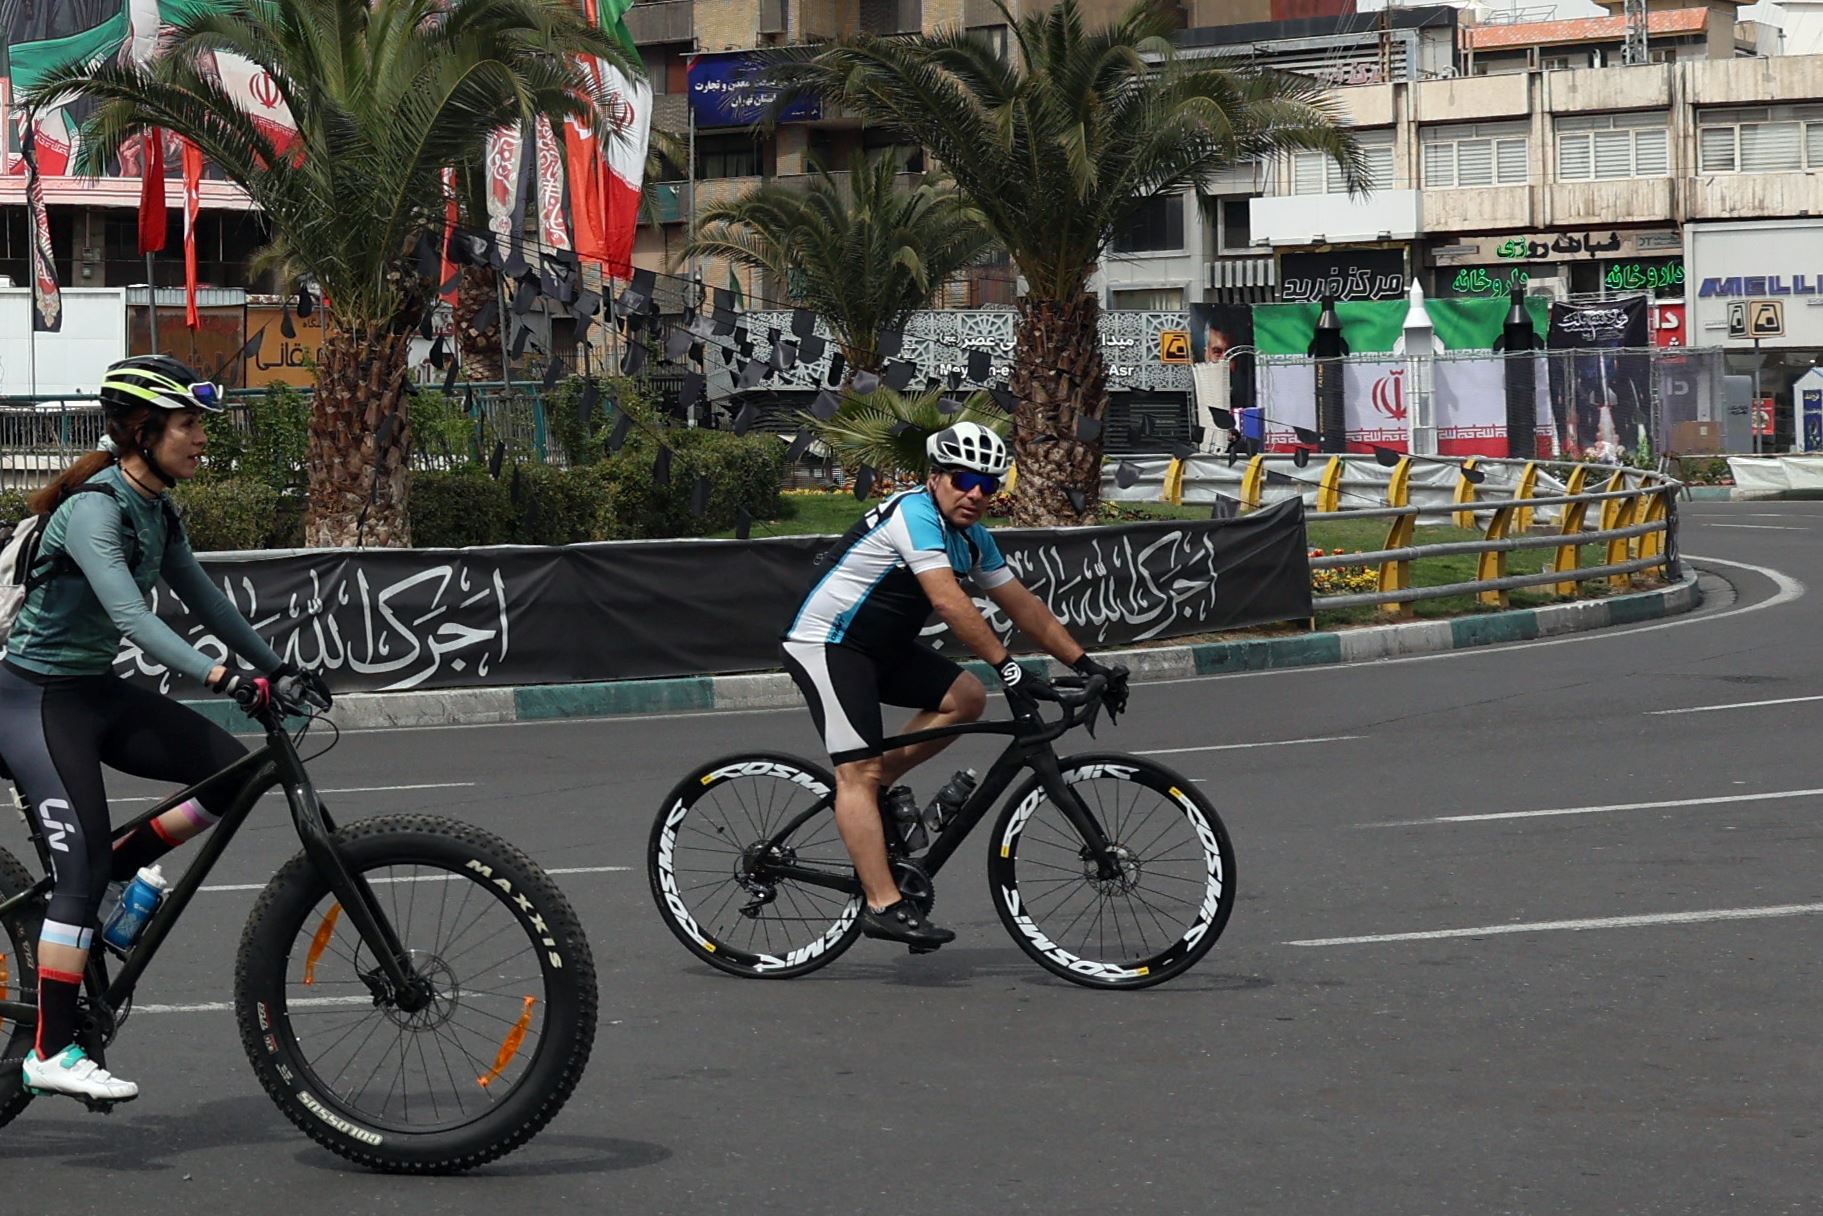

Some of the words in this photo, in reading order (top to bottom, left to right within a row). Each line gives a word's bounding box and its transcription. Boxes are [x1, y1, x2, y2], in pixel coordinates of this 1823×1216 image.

[695, 79, 721, 93] تجارت
[1604, 260, 1688, 291] داروخانه
[1101, 332, 1134, 347] میدا
[1108, 364, 1134, 377] Asr
[709, 761, 832, 799] COSM
[39, 798, 76, 853] Liv
[465, 858, 563, 969] MAXXIS
[296, 1089, 384, 1146] COLOSSUS
